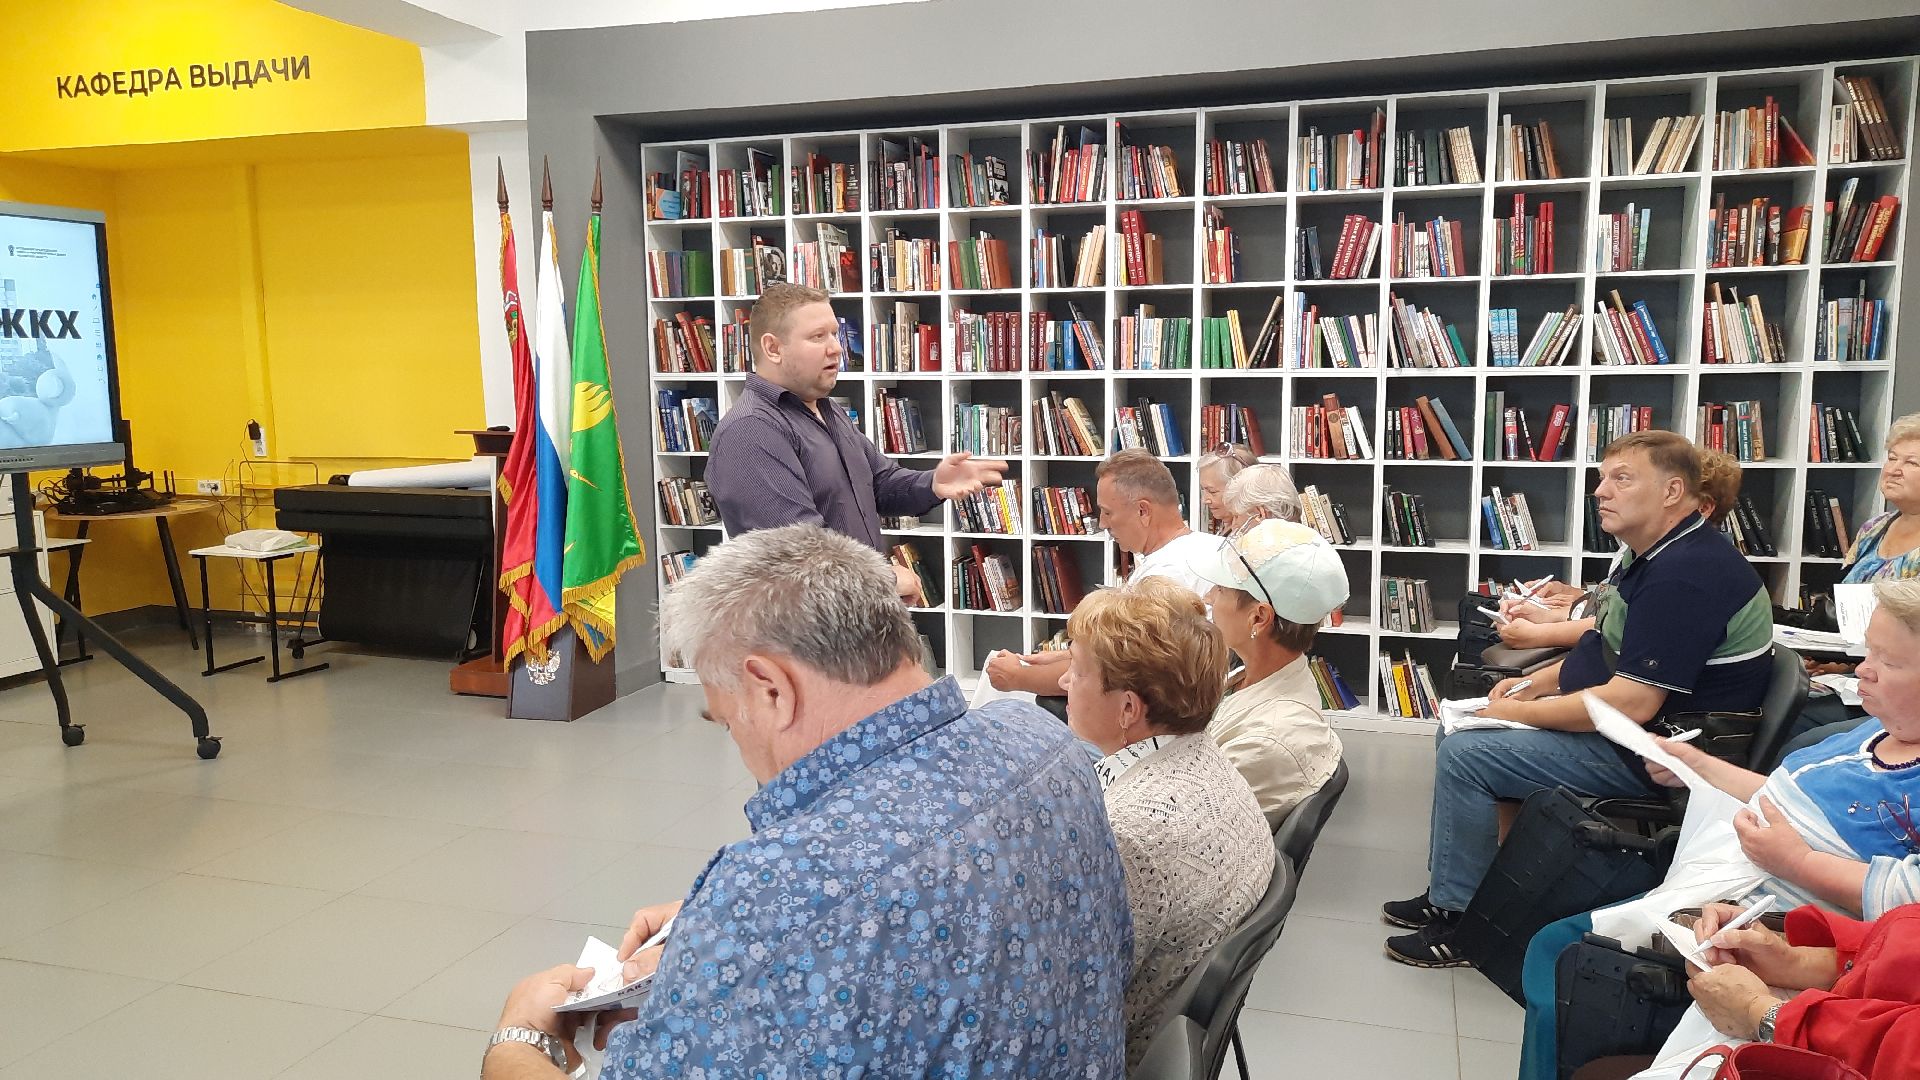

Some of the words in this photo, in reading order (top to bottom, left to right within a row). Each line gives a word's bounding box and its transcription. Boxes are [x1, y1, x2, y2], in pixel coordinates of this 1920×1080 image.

[57, 67, 182, 98] КАФЕДРА
[189, 55, 311, 90] ВЫДАЧИ
[1820, 545, 1826, 553] 3
